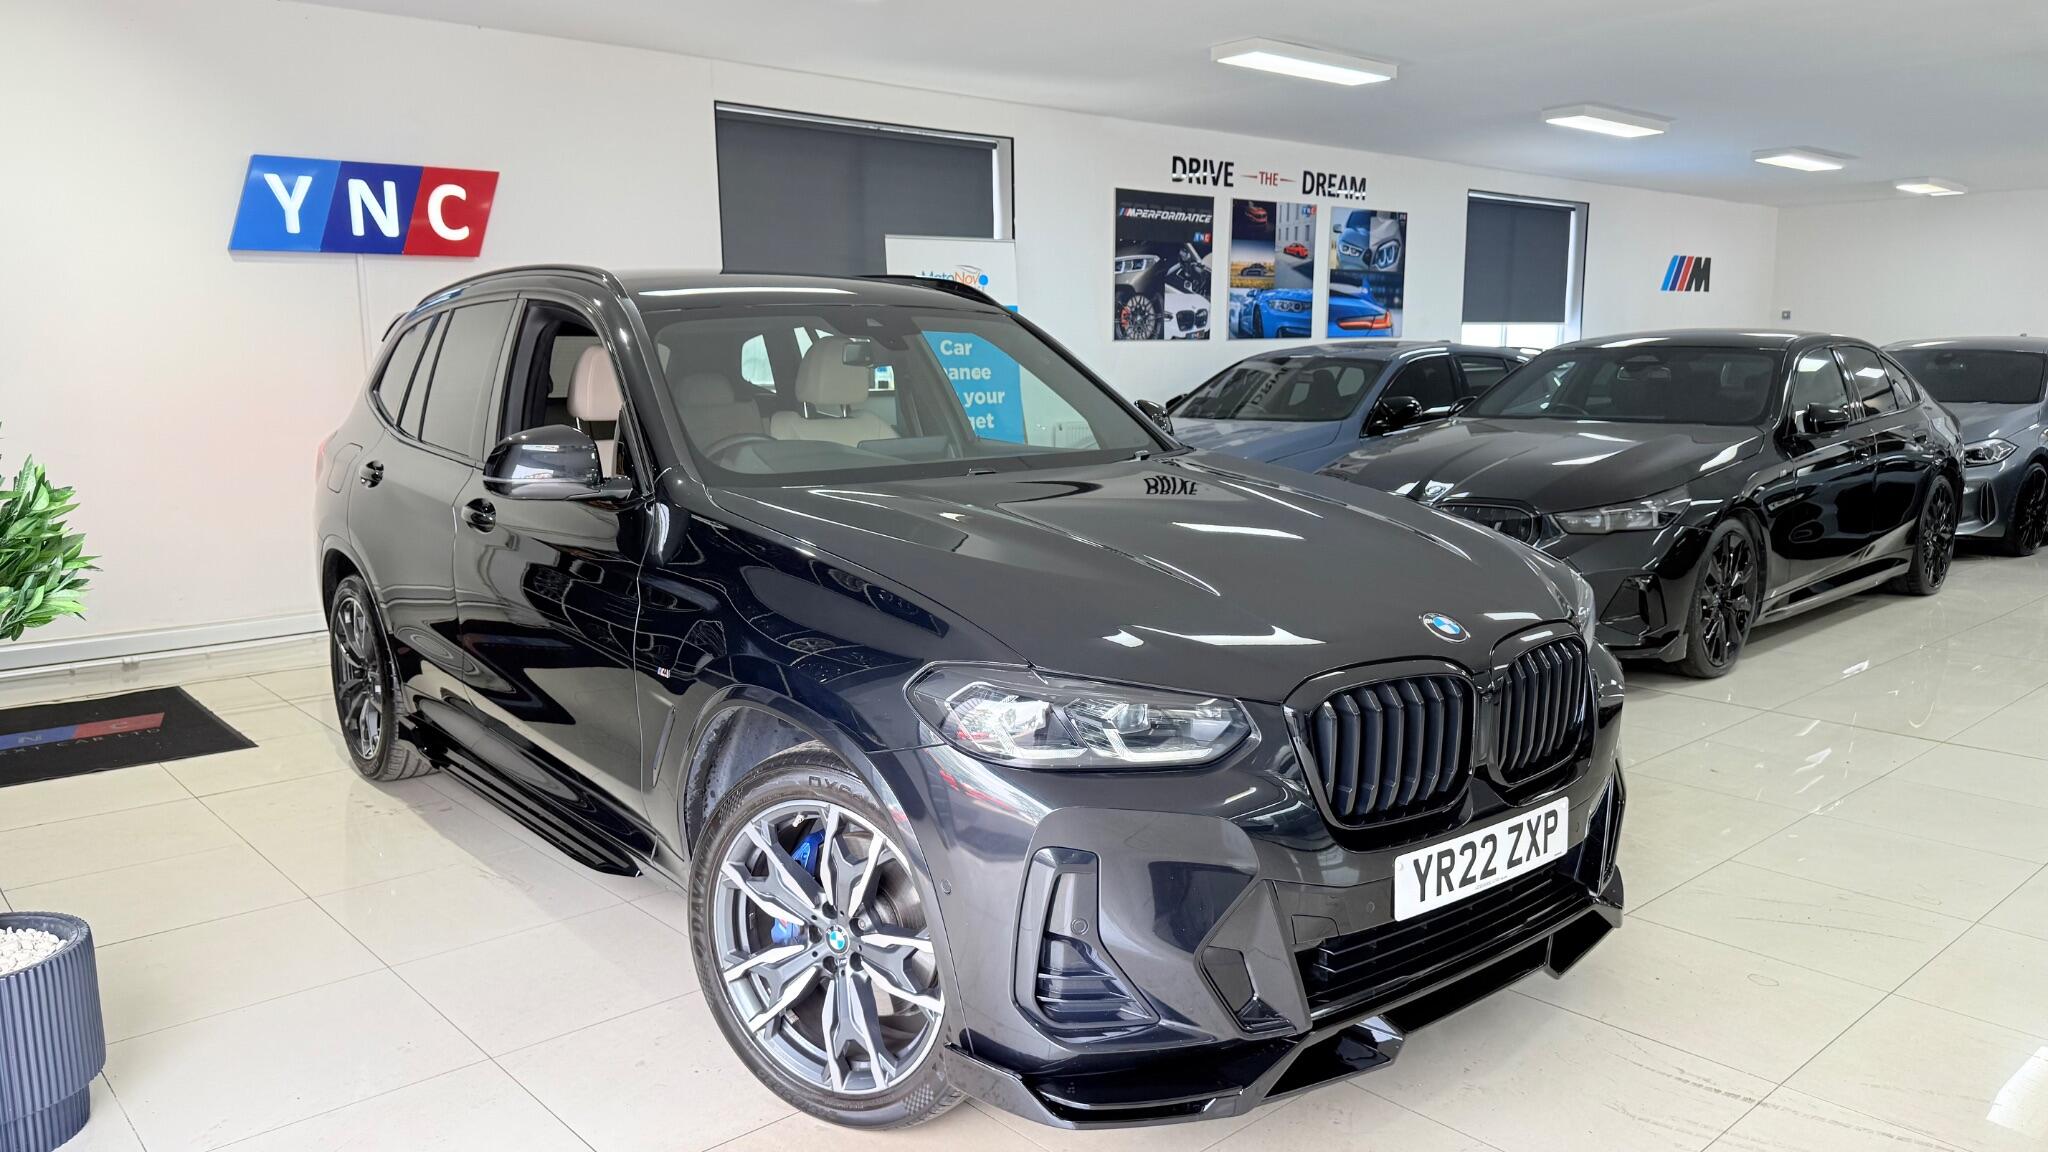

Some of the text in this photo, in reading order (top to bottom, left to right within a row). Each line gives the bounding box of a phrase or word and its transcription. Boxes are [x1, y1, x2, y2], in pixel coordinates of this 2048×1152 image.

[1172, 155, 1367, 201] DRIVE THE DREAM
[263, 173, 470, 241] YNC
[939, 339, 973, 356] Car
[944, 367, 992, 380] ance
[963, 391, 1006, 407] your
[1413, 809, 1559, 903] YR22 ZXP
